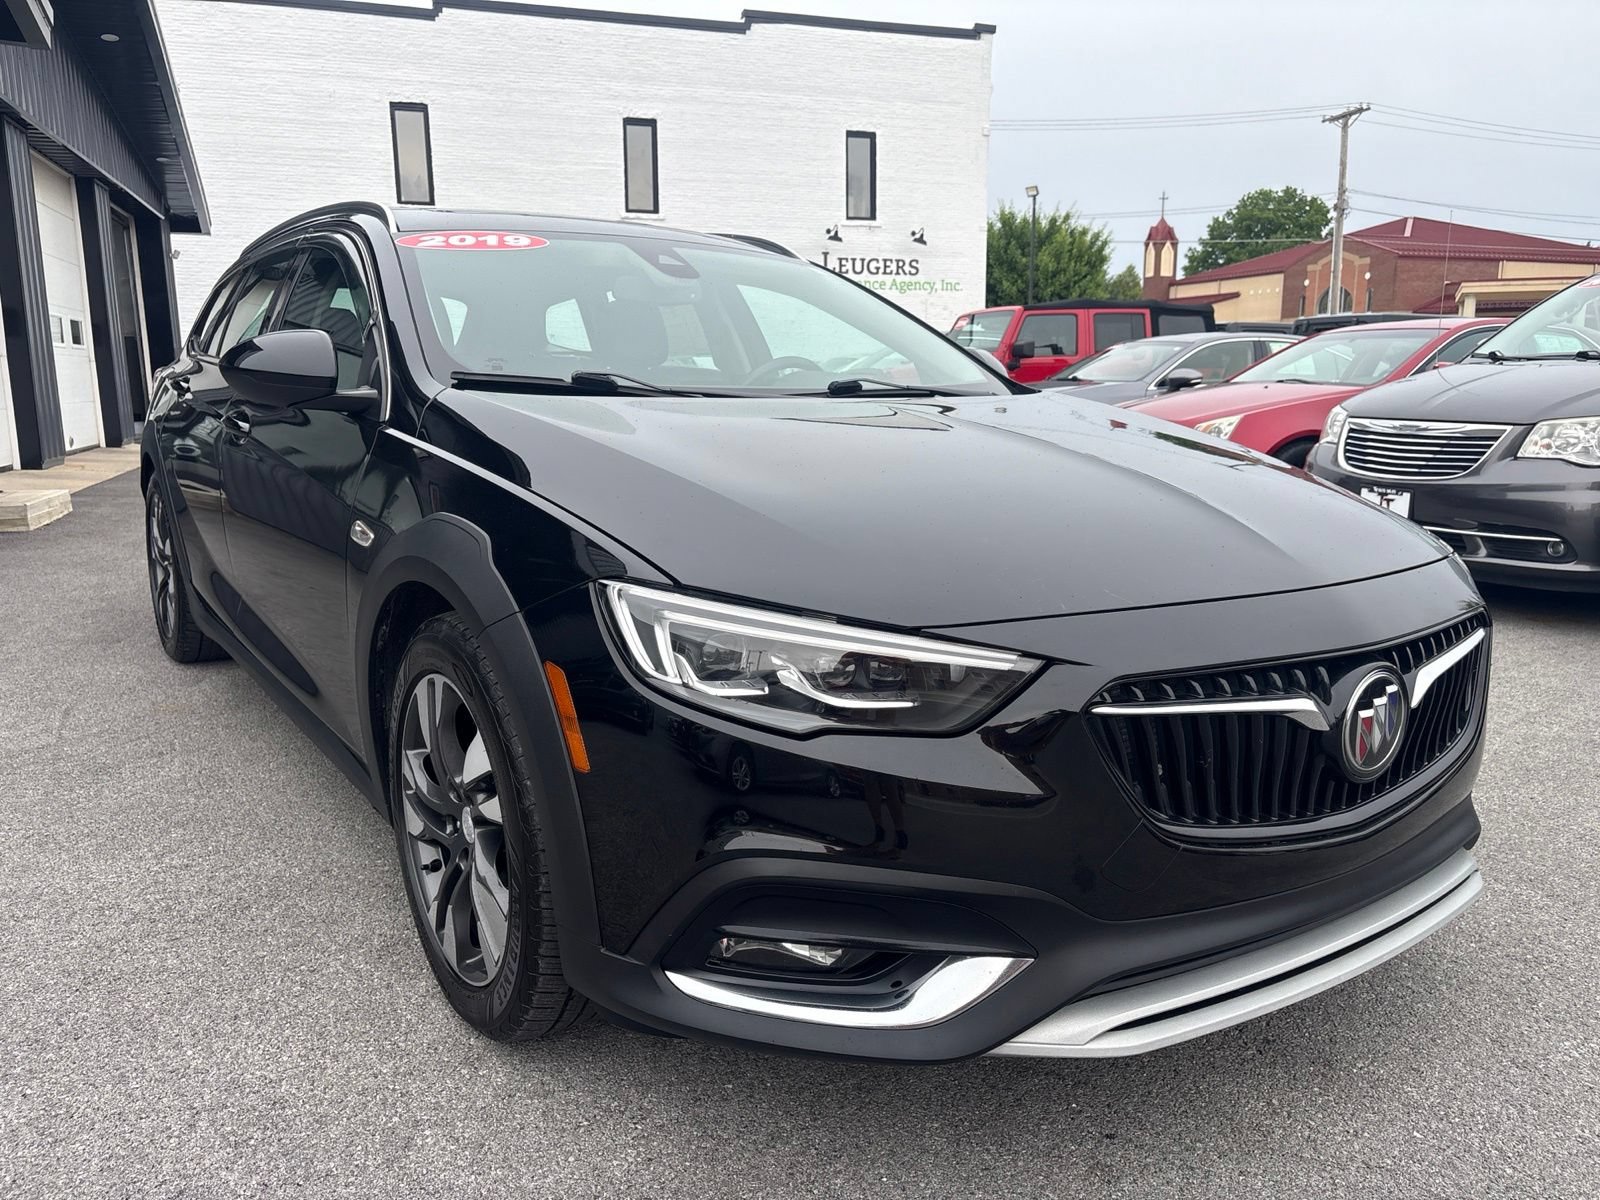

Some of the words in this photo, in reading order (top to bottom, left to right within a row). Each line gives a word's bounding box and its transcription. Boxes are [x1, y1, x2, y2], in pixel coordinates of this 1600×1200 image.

[417, 234, 532, 247] 2019
[821, 251, 920, 276] LEUGERS
[889, 278, 938, 295] Agency,
[940, 279, 964, 292] Inc.
